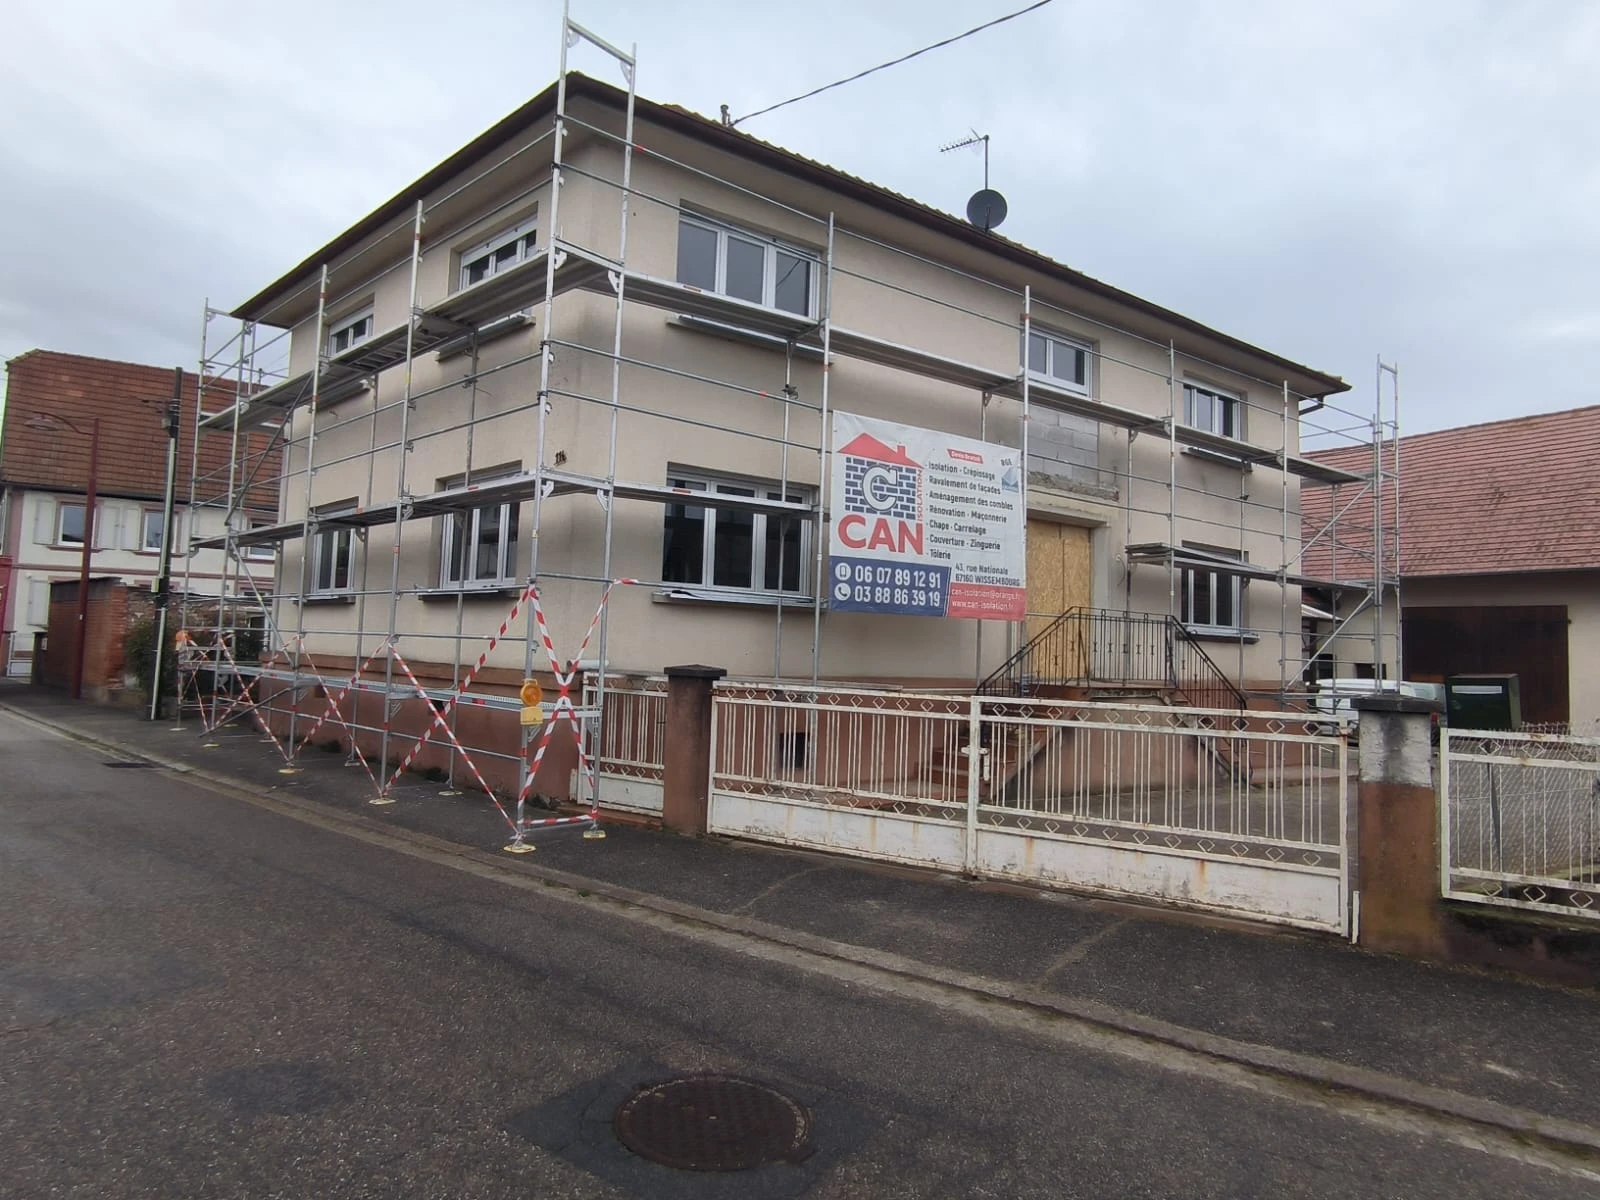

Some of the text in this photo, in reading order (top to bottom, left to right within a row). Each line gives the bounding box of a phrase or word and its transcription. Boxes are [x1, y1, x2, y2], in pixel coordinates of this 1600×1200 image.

[929, 462, 996, 481] Isolation Crépissage
[862, 464, 898, 512] C
[929, 476, 968, 488] Ravalement
[978, 484, 1001, 495] façades
[930, 490, 1013, 510] Aménagement des combles
[930, 505, 1007, 523] Rénovation Maçonnerie
[838, 514, 923, 555] CAN
[930, 520, 986, 535] Chape Carrelage
[930, 534, 1000, 550] Couverture Zinguerie
[930, 549, 951, 559] Tôlerie
[855, 565, 941, 588] 06 07 89 12 91
[979, 564, 1008, 575] Nationale
[956, 573, 1020, 586] 67160 WISSEMBOURG
[855, 586, 940, 607] 03 88 86 39 19
